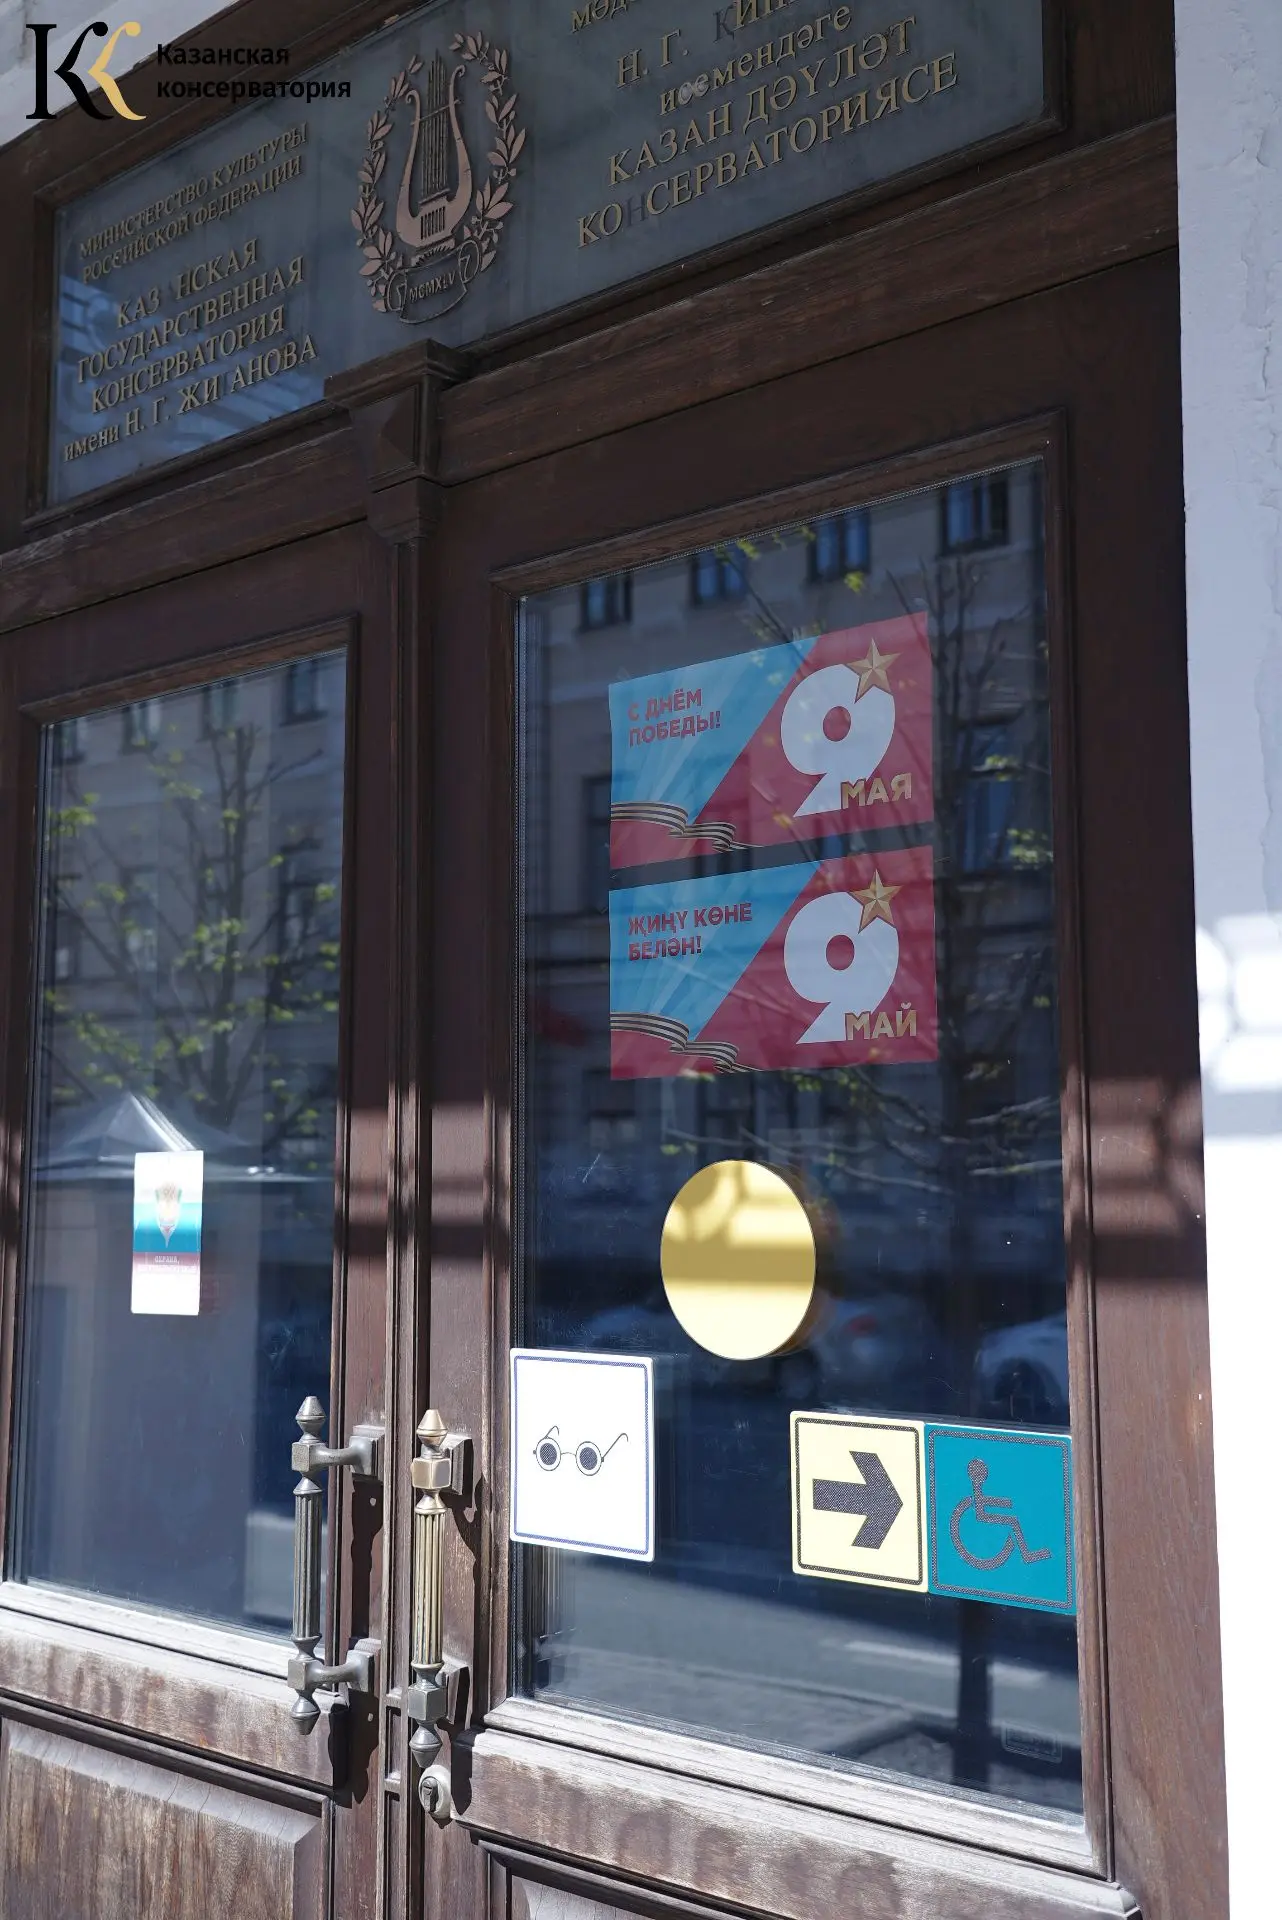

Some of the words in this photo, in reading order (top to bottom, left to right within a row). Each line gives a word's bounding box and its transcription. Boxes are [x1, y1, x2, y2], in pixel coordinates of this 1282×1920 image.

[607, 101, 732, 187] КАЗАН
[742, 15, 916, 134] ДӘҮЛӘТ
[659, 29, 689, 67] Г.
[659, 5, 852, 116] исемендәге
[80, 177, 208, 261] МИНИСТЕРСТВО
[212, 121, 309, 189] КУЛЬТУРЫ
[82, 212, 191, 284] РОССИЙСКОЙ
[193, 156, 302, 227] ФЕДЕРАЦИИ
[77, 255, 305, 383] ГОСУДАРСТВЕННАЯ
[117, 238, 258, 328] КАЗНСКАЯ
[63, 423, 121, 463] имени
[125, 407, 147, 437] Н.
[176, 334, 319, 416] ЖИАНОВА
[91, 304, 285, 414] КОНСЕРВАТОРИЯ
[628, 704, 639, 721] С
[645, 688, 703, 721] ДНЁМ
[628, 711, 722, 747] ПОБЕДЫ!
[781, 664, 896, 817] 9
[840, 772, 913, 810] МАЯ
[628, 934, 702, 962] БЕЛӘН!
[693, 902, 753, 928] КӨНЕ
[784, 891, 899, 1044] 9
[844, 1001, 917, 1041] МАЙ
